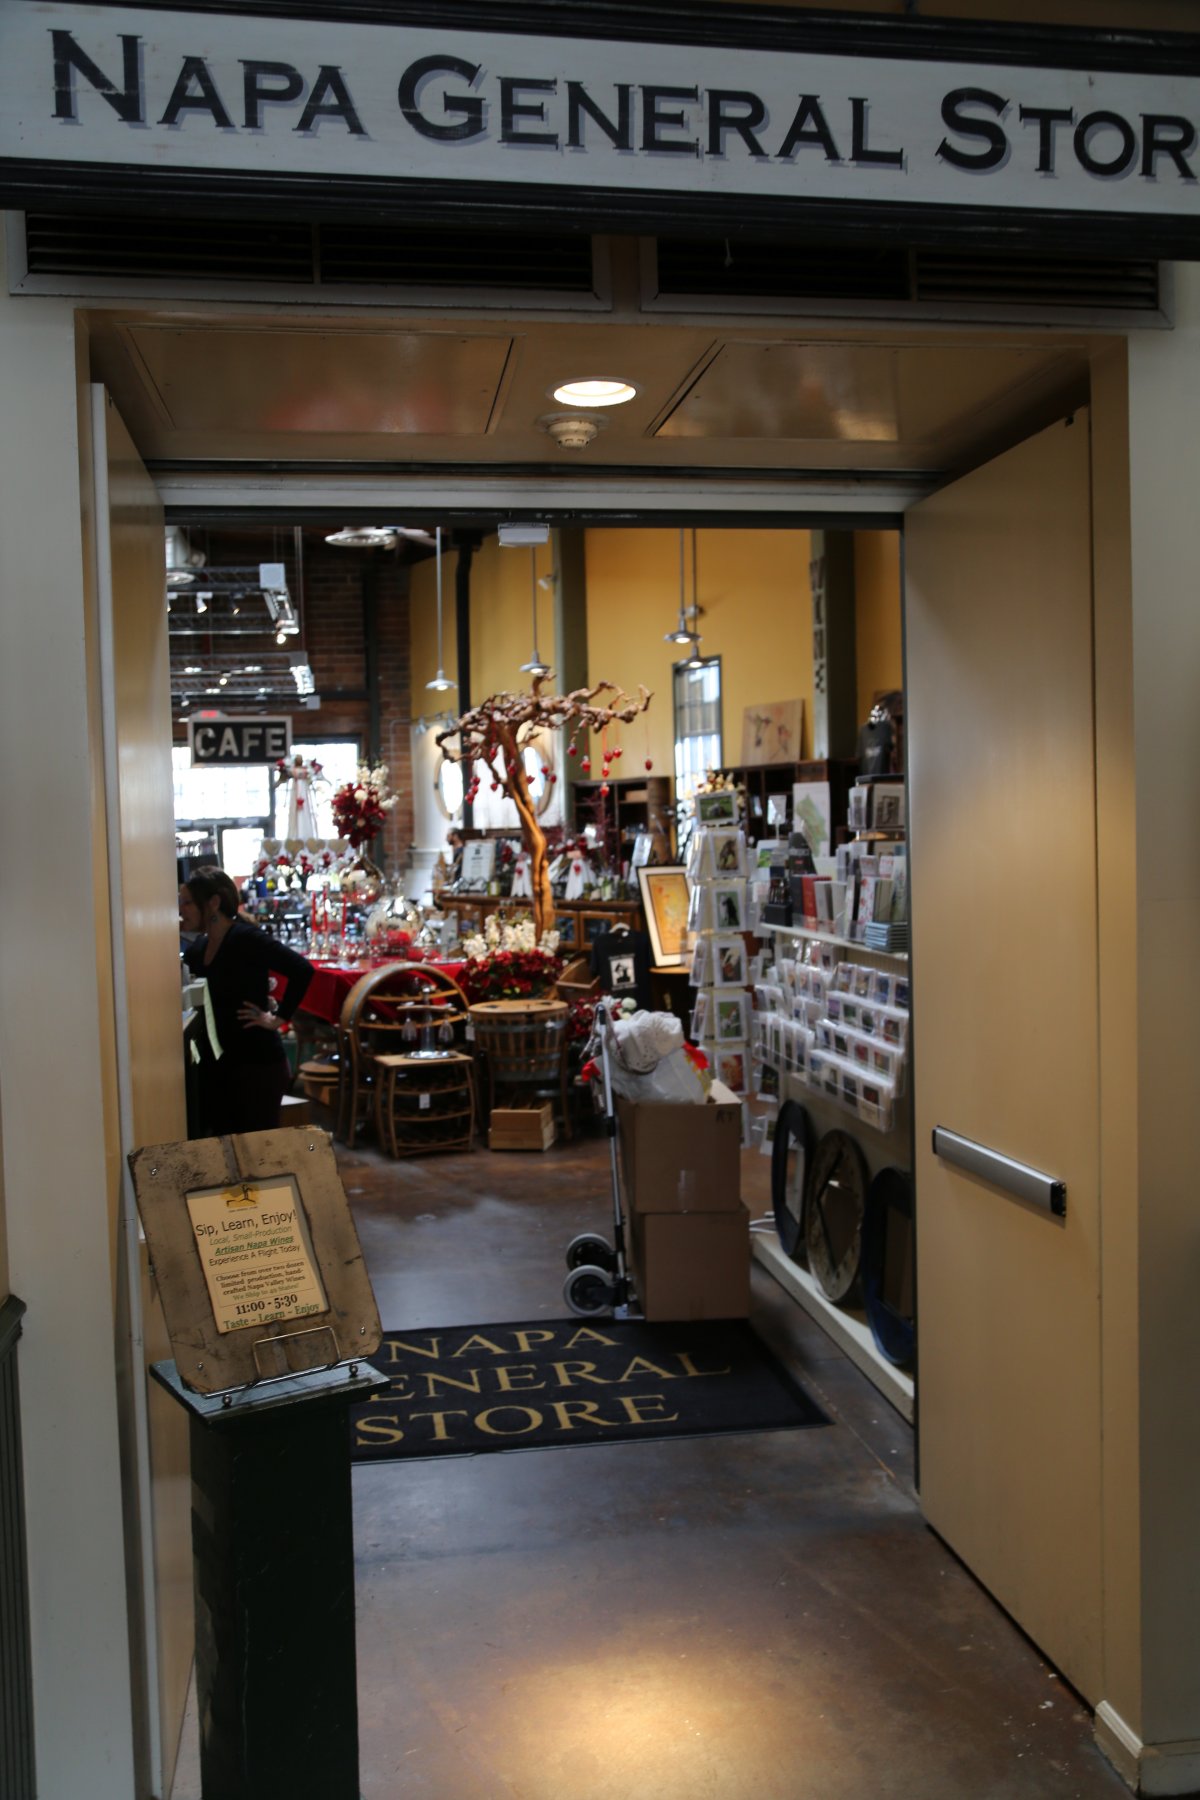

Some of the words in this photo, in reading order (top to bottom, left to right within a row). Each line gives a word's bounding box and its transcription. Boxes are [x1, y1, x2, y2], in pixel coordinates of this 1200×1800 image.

[47, 28, 371, 138] NAPA
[397, 53, 905, 170] GENERAL
[195, 727, 286, 757] CAFE
[195, 1224, 218, 1238] Sip,
[221, 1218, 258, 1232] Learn,
[261, 1209, 297, 1226] Enjoy!
[209, 1253, 250, 1267] Experience
[250, 1251, 256, 1259] A
[257, 1246, 279, 1258] Flight
[280, 1244, 300, 1254] Today
[214, 1243, 245, 1256] Artisan
[246, 1240, 268, 1251] Napa
[270, 1235, 294, 1247] Wines
[215, 1273, 239, 1282] Choose
[240, 1270, 257, 1278] from
[220, 1279, 244, 1288] limited
[247, 1282, 264, 1292] Napa
[264, 1278, 284, 1288] Valley
[223, 1318, 249, 1329] Taste
[258, 1310, 286, 1322] Learn
[294, 1303, 320, 1316] Enjoy
[235, 1300, 265, 1315] 11:00
[273, 1293, 298, 1310] 5:30
[384, 1327, 622, 1363] NAPA
[355, 1394, 680, 1447] STORE
